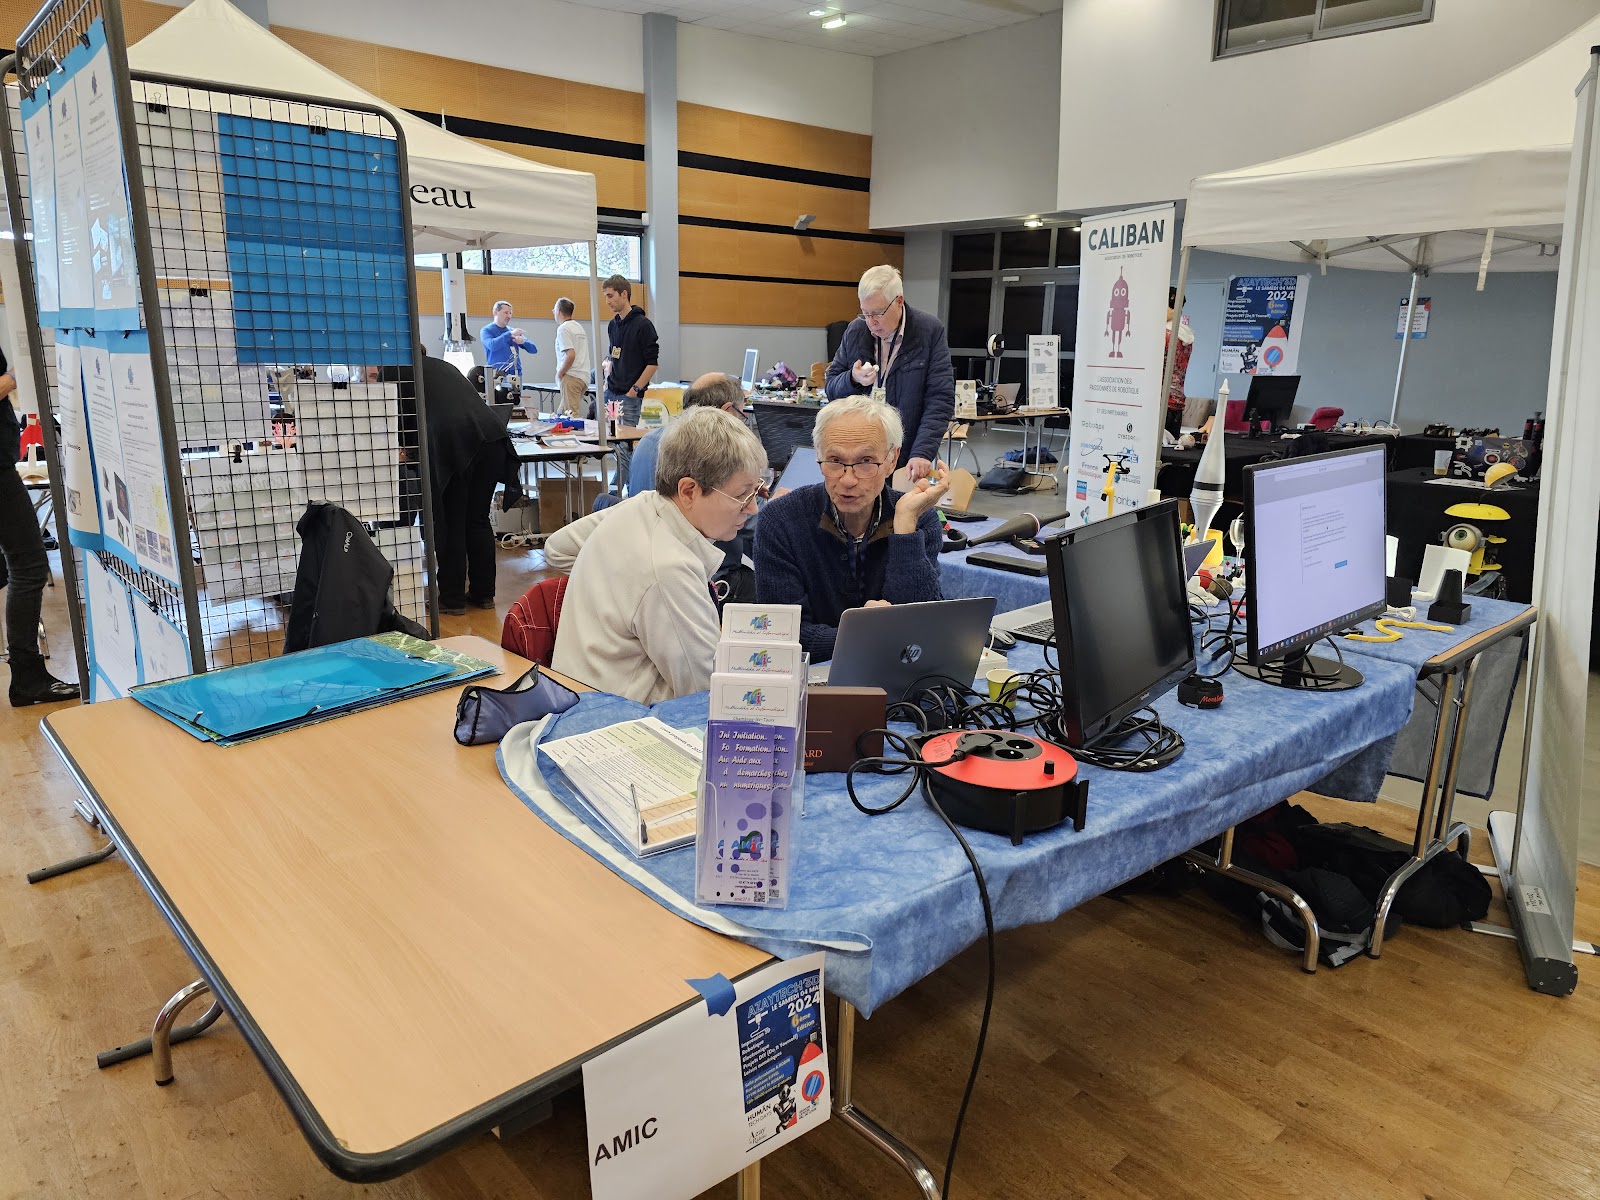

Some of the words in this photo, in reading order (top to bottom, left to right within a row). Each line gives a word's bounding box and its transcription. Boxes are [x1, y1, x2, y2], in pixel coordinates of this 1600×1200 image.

[1088, 219, 1165, 251] CALIBAN
[1266, 291, 1294, 301] 2024
[737, 768, 772, 779] démarches
[733, 781, 771, 791] numériques
[771, 1004, 778, 1012] LE
[778, 993, 800, 1008] SAMEDI
[800, 989, 808, 997] 04
[787, 991, 820, 1018] 2024
[595, 1117, 658, 1167] AMIC
